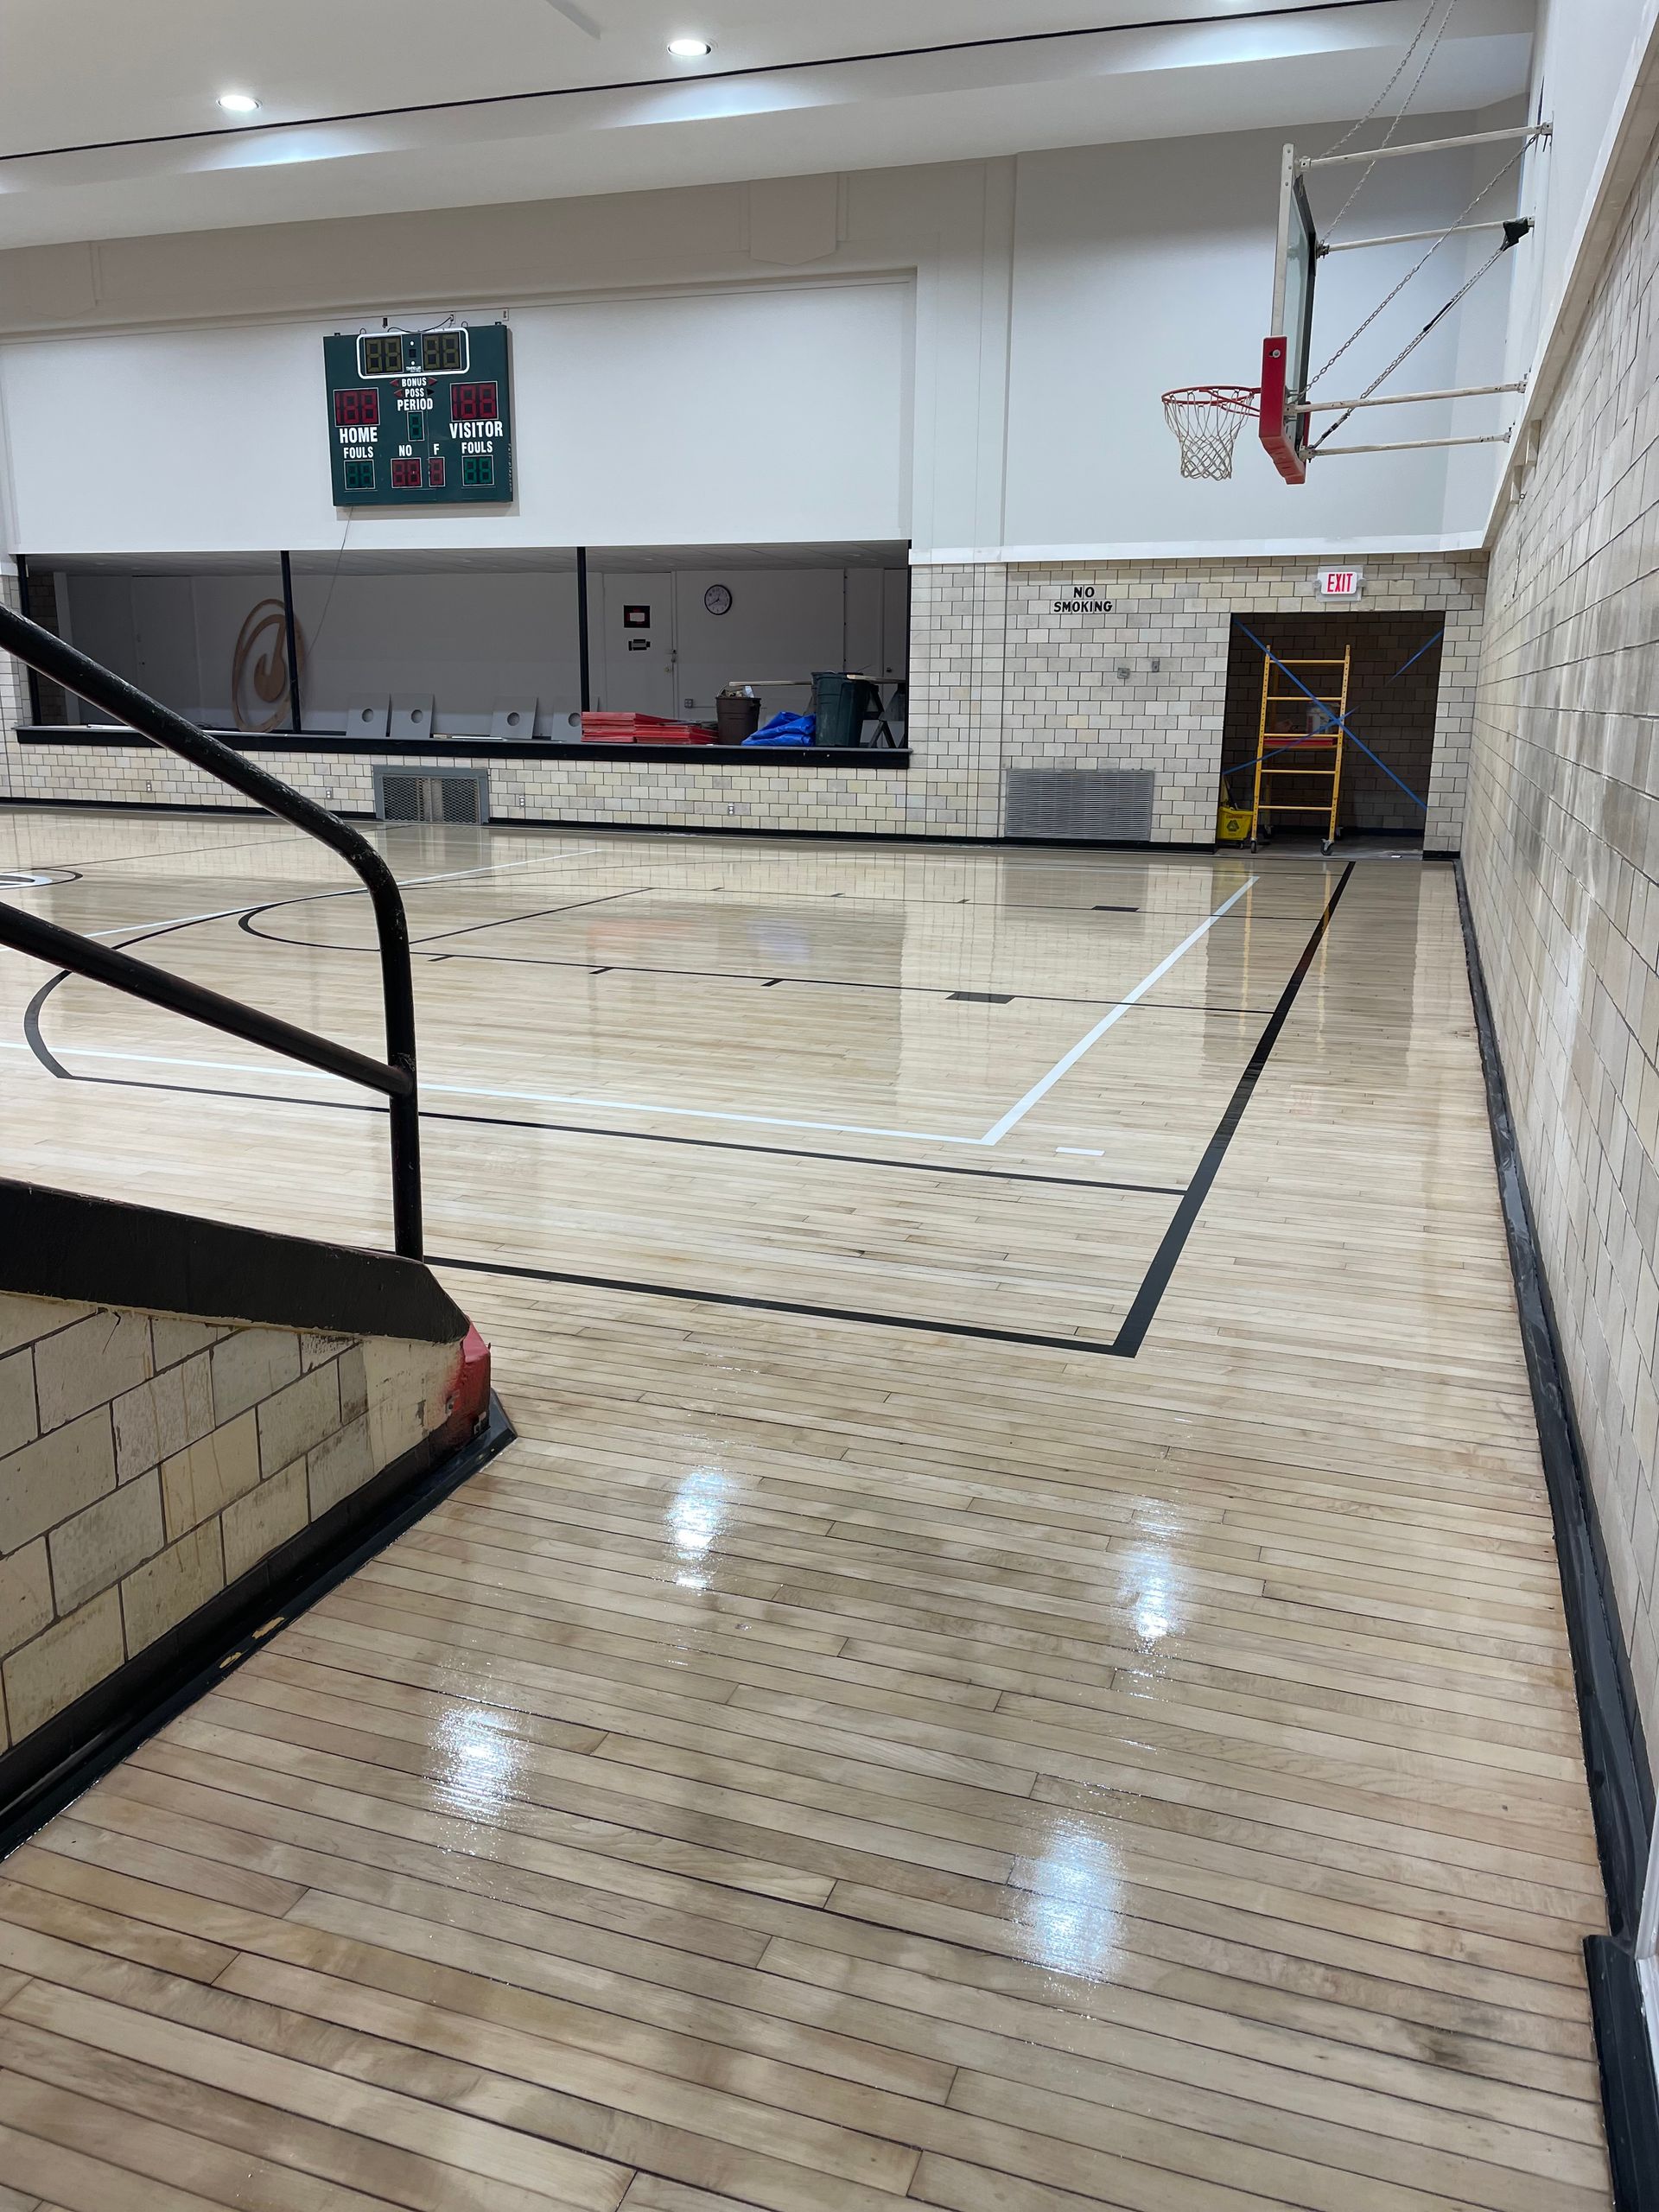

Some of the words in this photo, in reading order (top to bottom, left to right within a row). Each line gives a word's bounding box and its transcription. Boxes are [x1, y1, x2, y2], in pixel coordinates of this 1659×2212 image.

[401, 377, 427, 387] BONUS
[404, 387, 425, 397] POSS
[397, 397, 434, 411] PERIOD
[339, 426, 378, 444] HOME
[448, 421, 504, 439] VISITOR
[343, 446, 374, 459] FOULS
[398, 444, 412, 456] NO
[433, 443, 440, 455] F
[461, 440, 493, 454] FOULS
[1326, 573, 1353, 593] EXIT
[1073, 586, 1095, 598] NO
[1053, 601, 1113, 613] SMOKING
